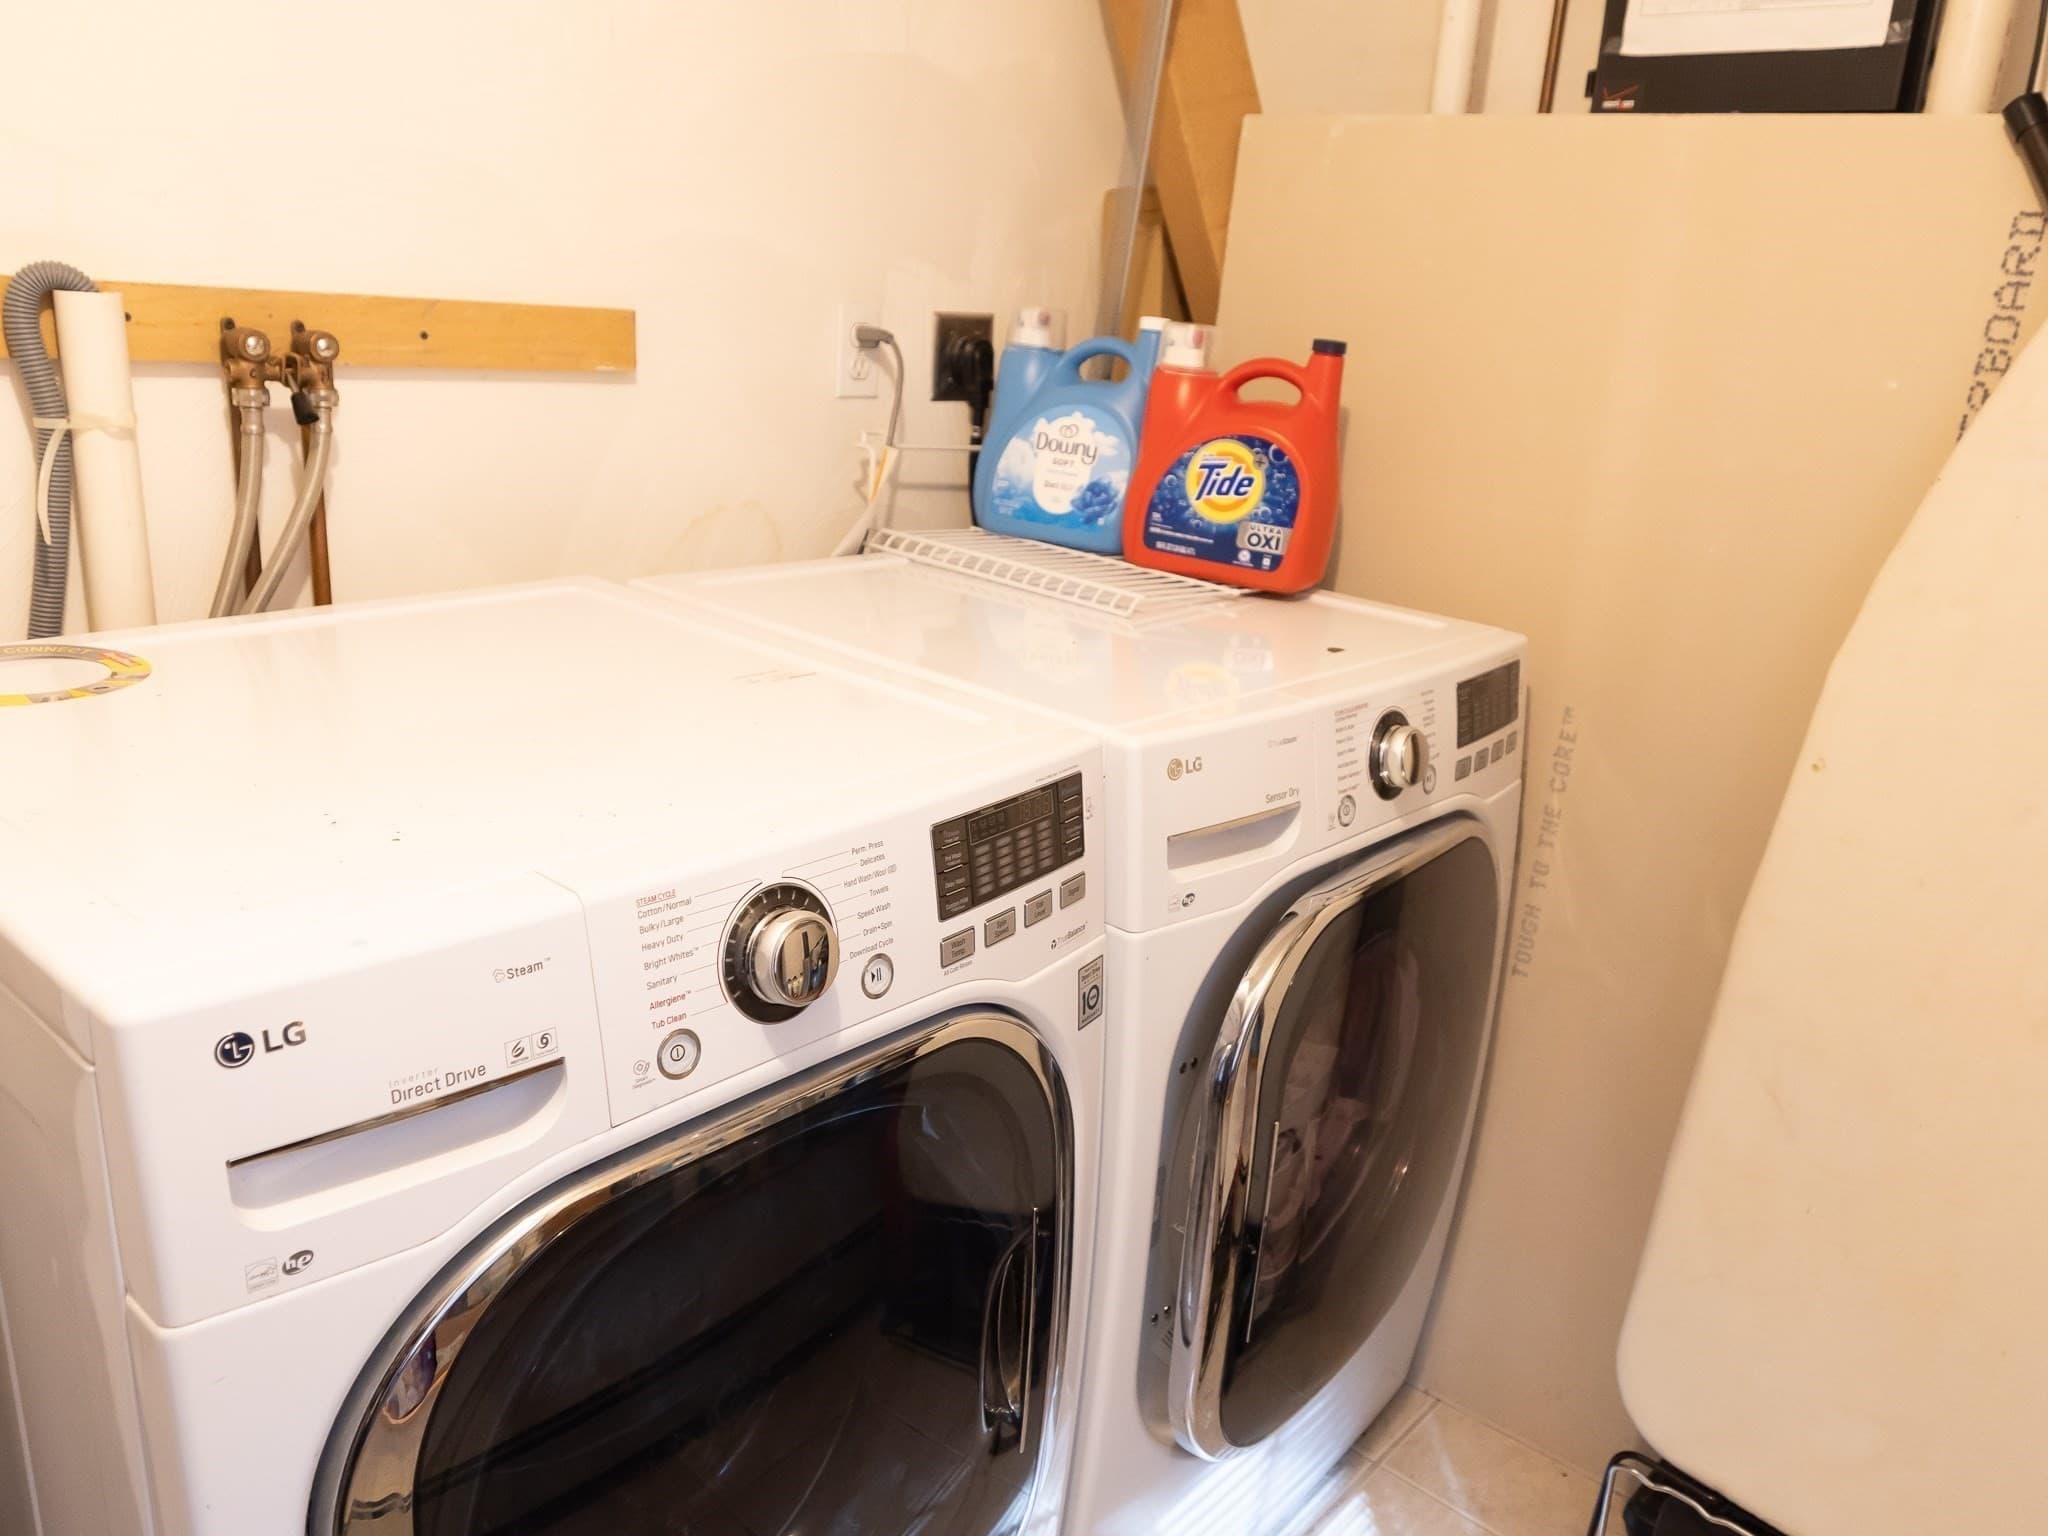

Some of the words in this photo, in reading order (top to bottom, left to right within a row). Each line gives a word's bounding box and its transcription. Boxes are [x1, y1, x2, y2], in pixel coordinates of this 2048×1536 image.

[1036, 431, 1098, 465] Downy
[1195, 461, 1255, 501] Tide
[1250, 525, 1282, 535] ULTRA
[1247, 532, 1281, 551] OXI
[3, 646, 93, 655] CONNECT
[1185, 756, 1202, 774] LG
[1265, 790, 1288, 804] Sensor
[1537, 804, 1562, 850] THE
[859, 853, 885, 867] Delicates
[1529, 860, 1550, 889] TO
[636, 896, 657, 908] STEAM
[657, 888, 676, 901] CYCLE
[637, 896, 692, 920] Cotton/Normal
[639, 915, 684, 935] Bulky/Large
[641, 940, 665, 953] Heavy
[666, 933, 684, 945] Duty
[1511, 903, 1541, 978] TOUGH
[849, 943, 879, 960] Download
[643, 957, 667, 970] Bright
[646, 974, 678, 991] Sanitary
[1082, 984, 1100, 1016] 10
[651, 1019, 666, 1030] Tub
[666, 1011, 687, 1025] Clean
[262, 1020, 306, 1054] LG
[391, 1077, 441, 1104] Direct
[445, 1064, 487, 1087] Drive
